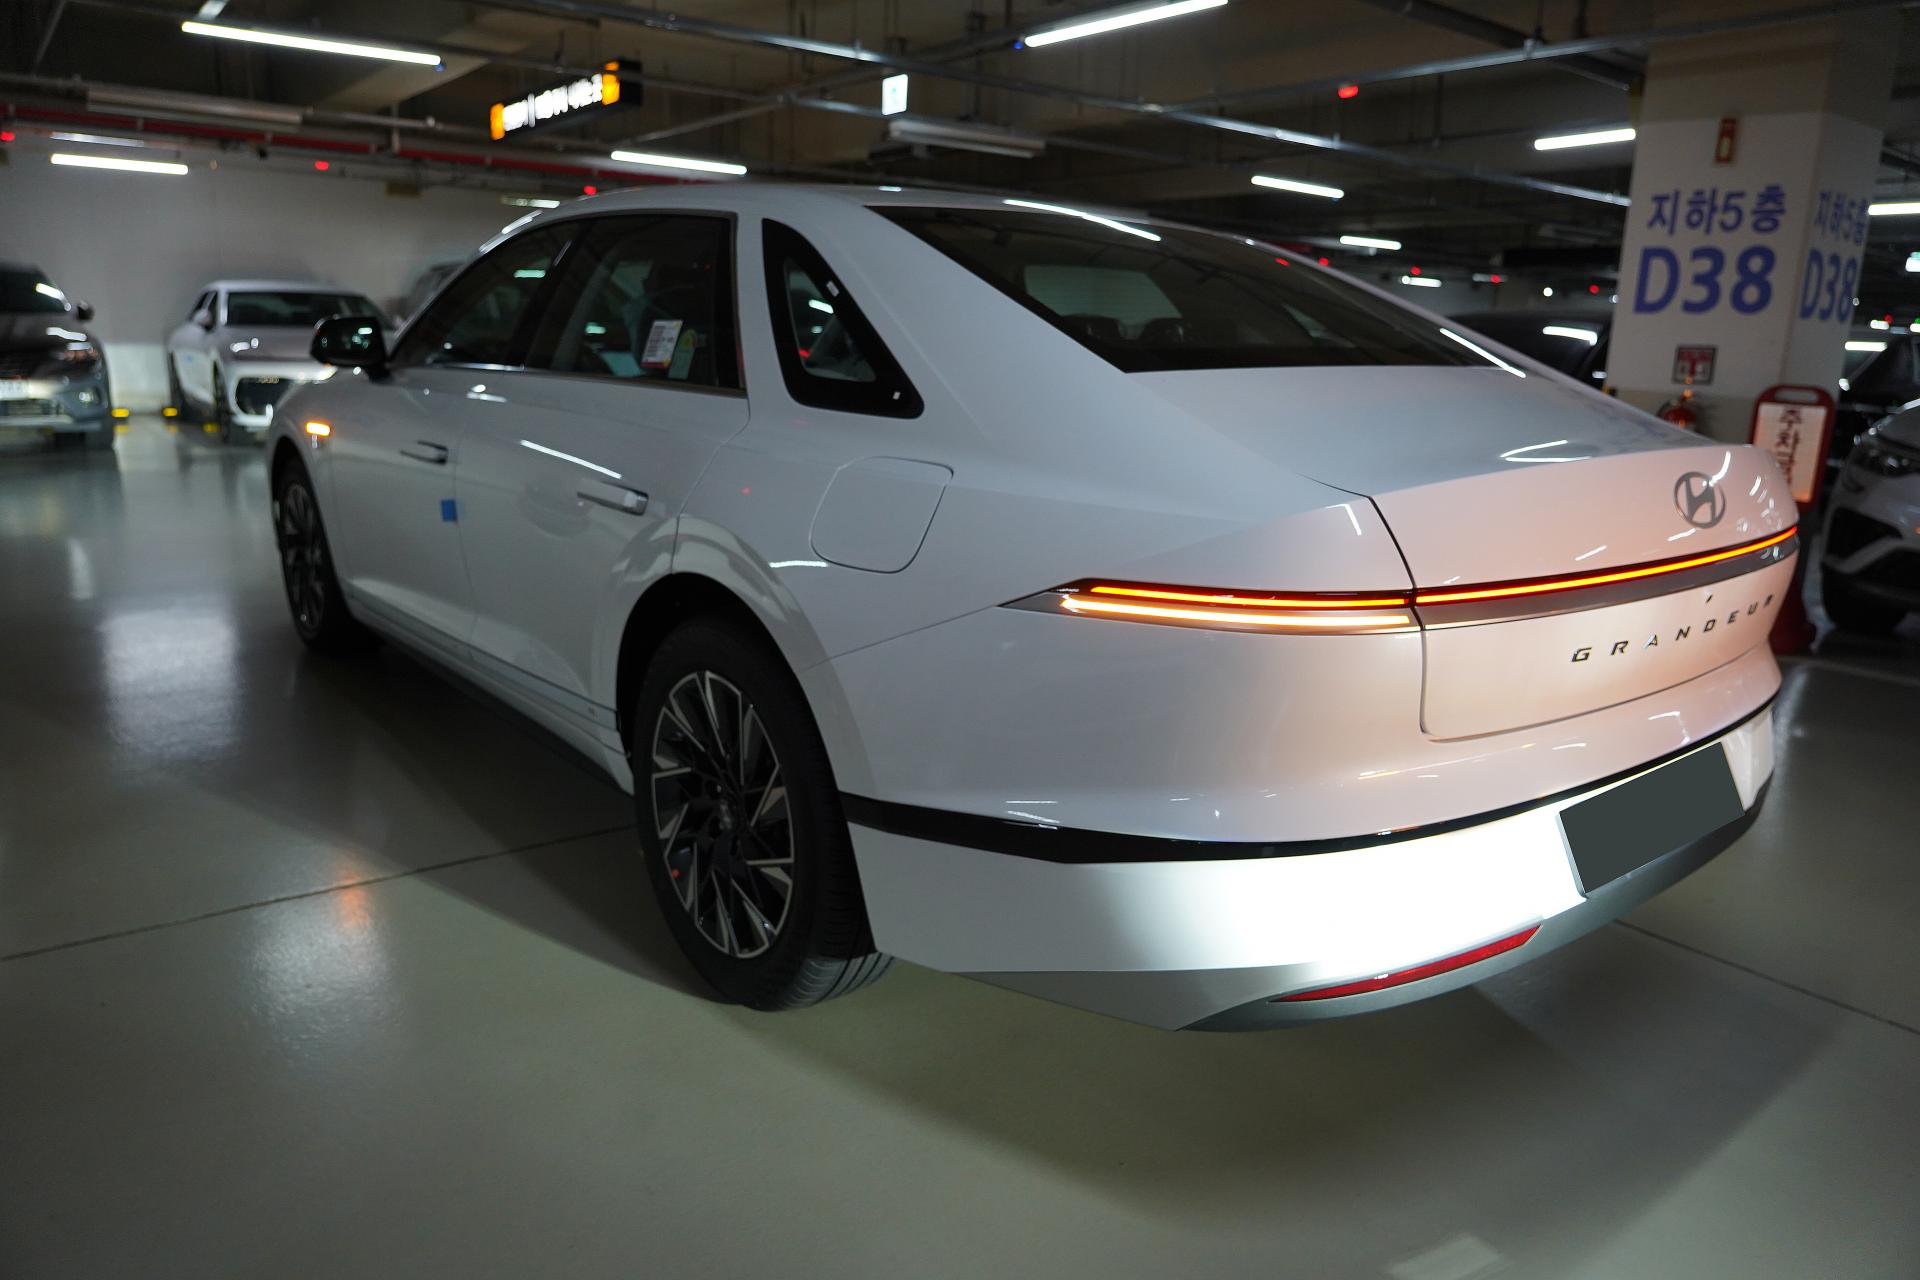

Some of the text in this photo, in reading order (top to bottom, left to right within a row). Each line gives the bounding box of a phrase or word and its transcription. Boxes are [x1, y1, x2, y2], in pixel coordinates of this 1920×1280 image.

[1648, 184, 1787, 235] 지하5층
[1634, 245, 1776, 315] D38
[1800, 249, 1857, 322] D38
